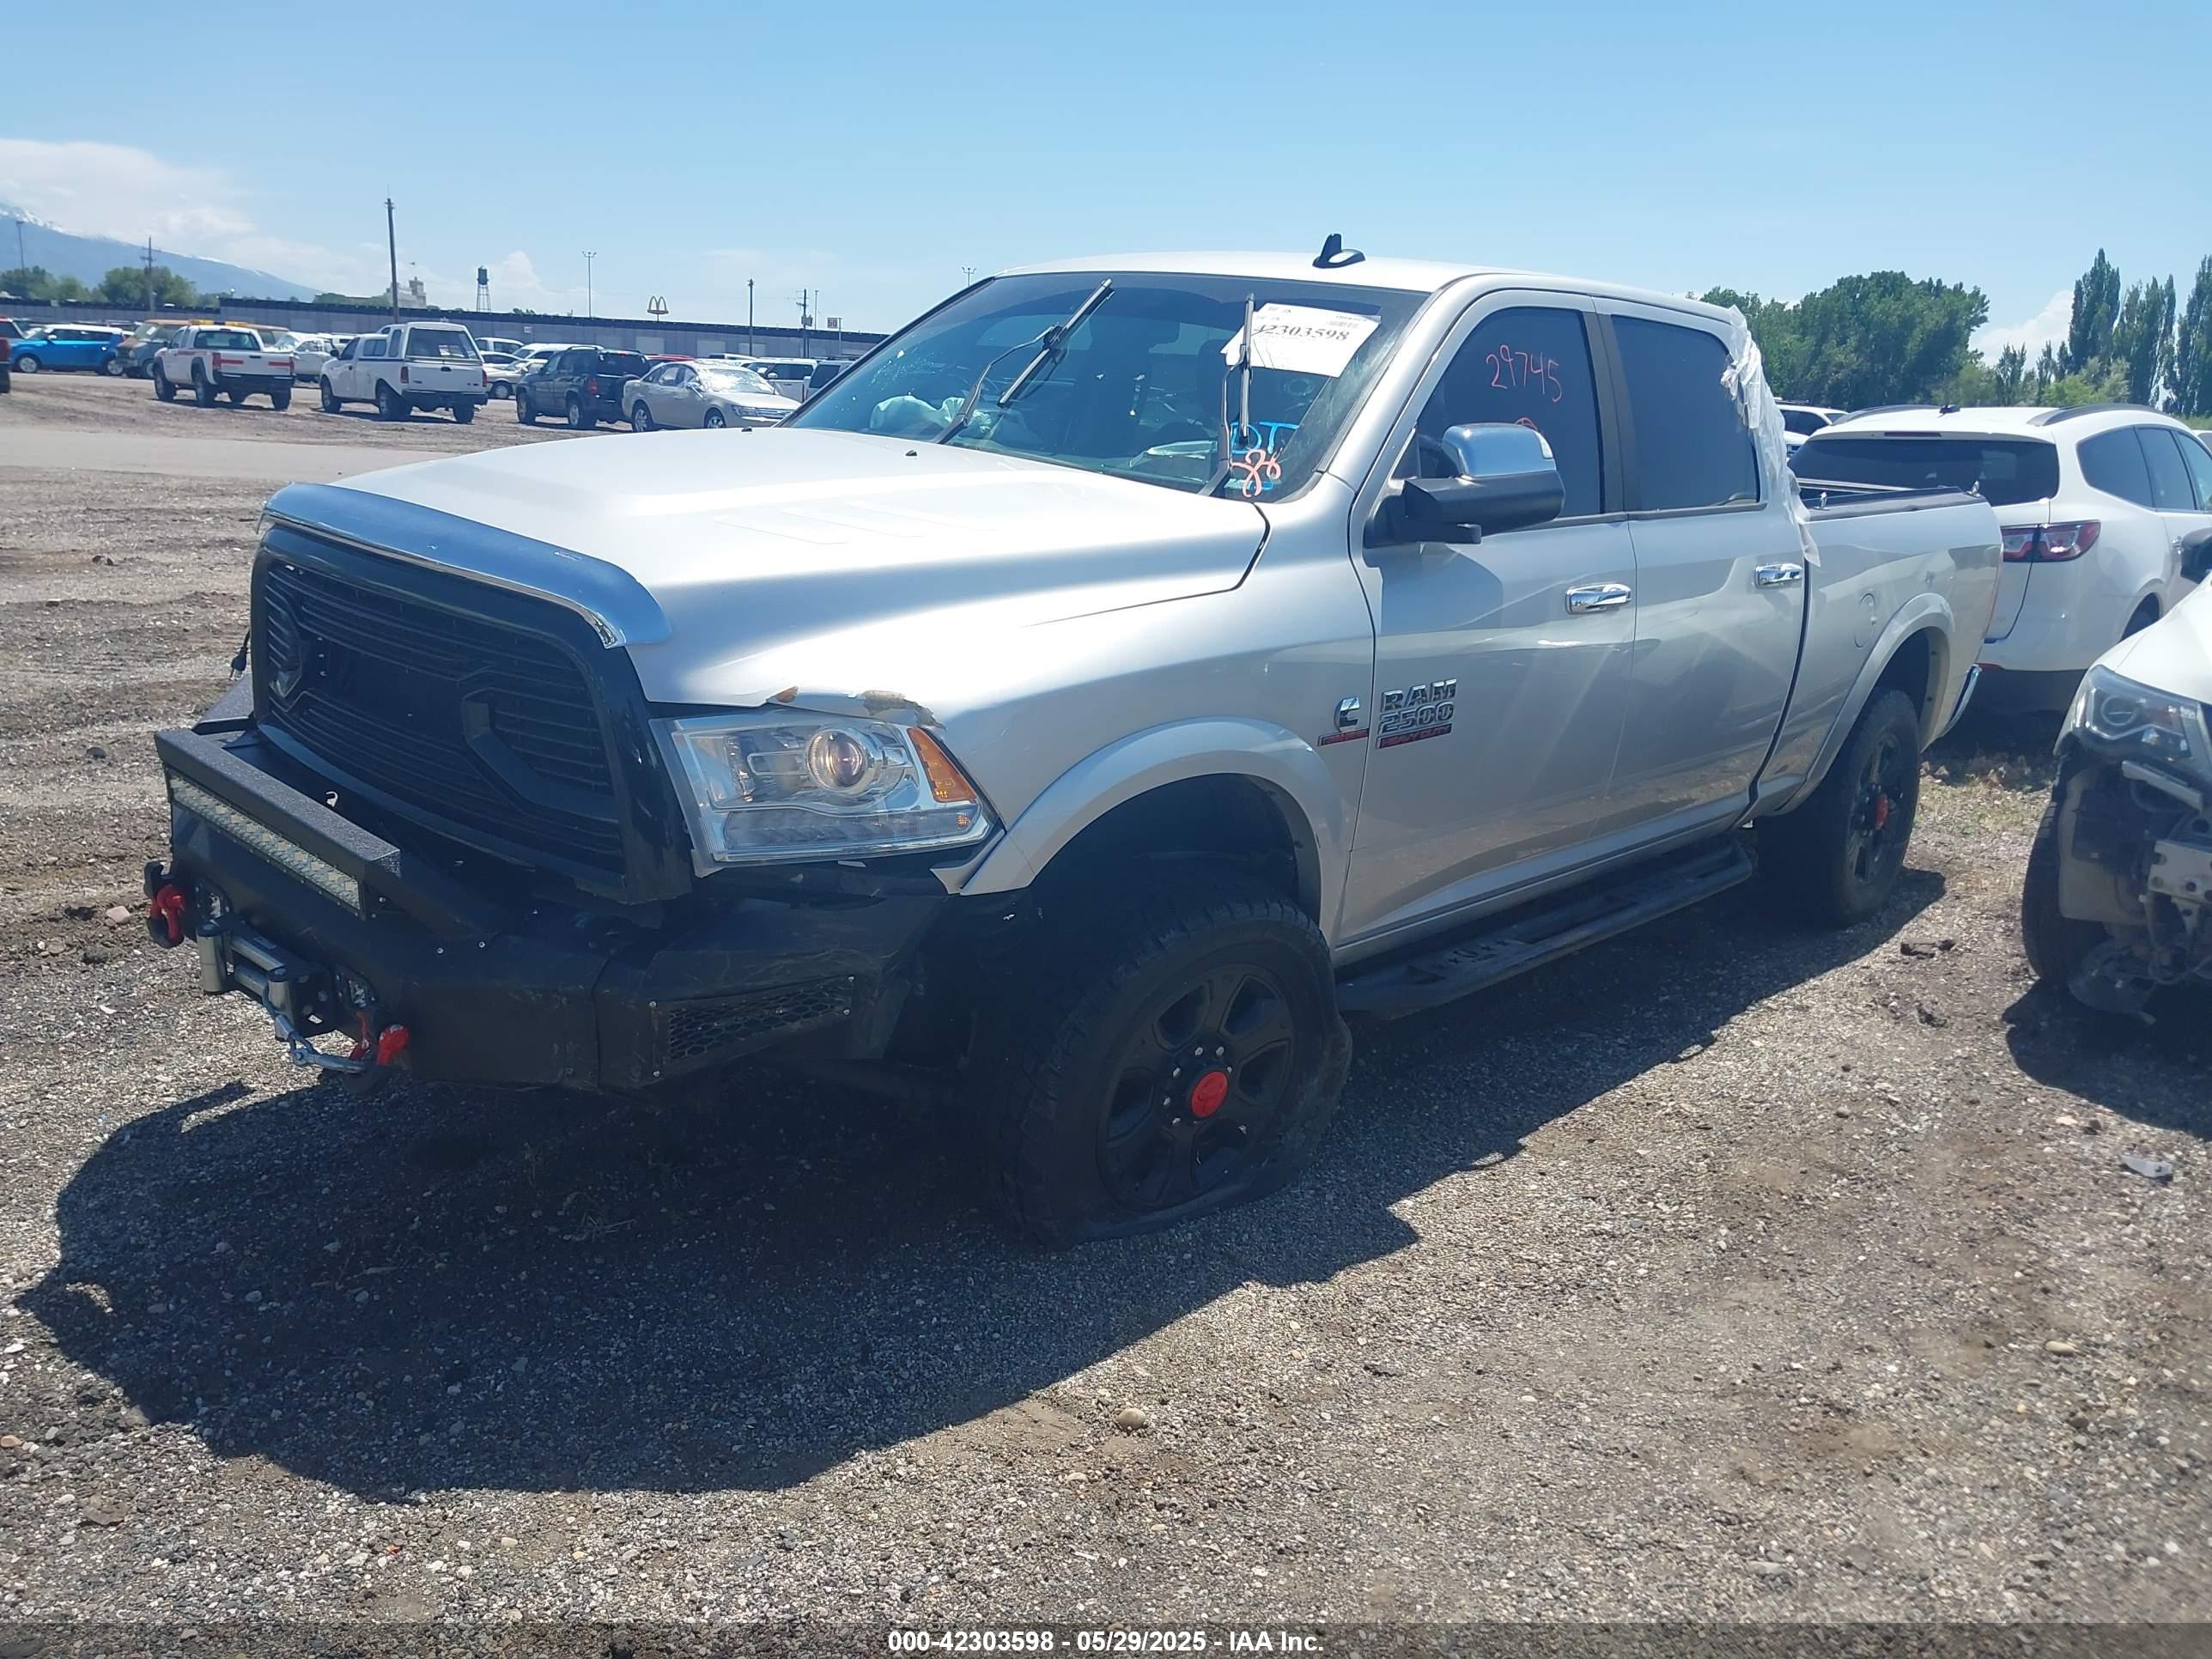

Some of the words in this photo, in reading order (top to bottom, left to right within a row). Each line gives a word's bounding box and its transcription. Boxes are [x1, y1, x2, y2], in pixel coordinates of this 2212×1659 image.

[1485, 344, 1563, 403] 29745
[1381, 678, 1457, 712] RAM
[1377, 701, 1455, 735] 2500
